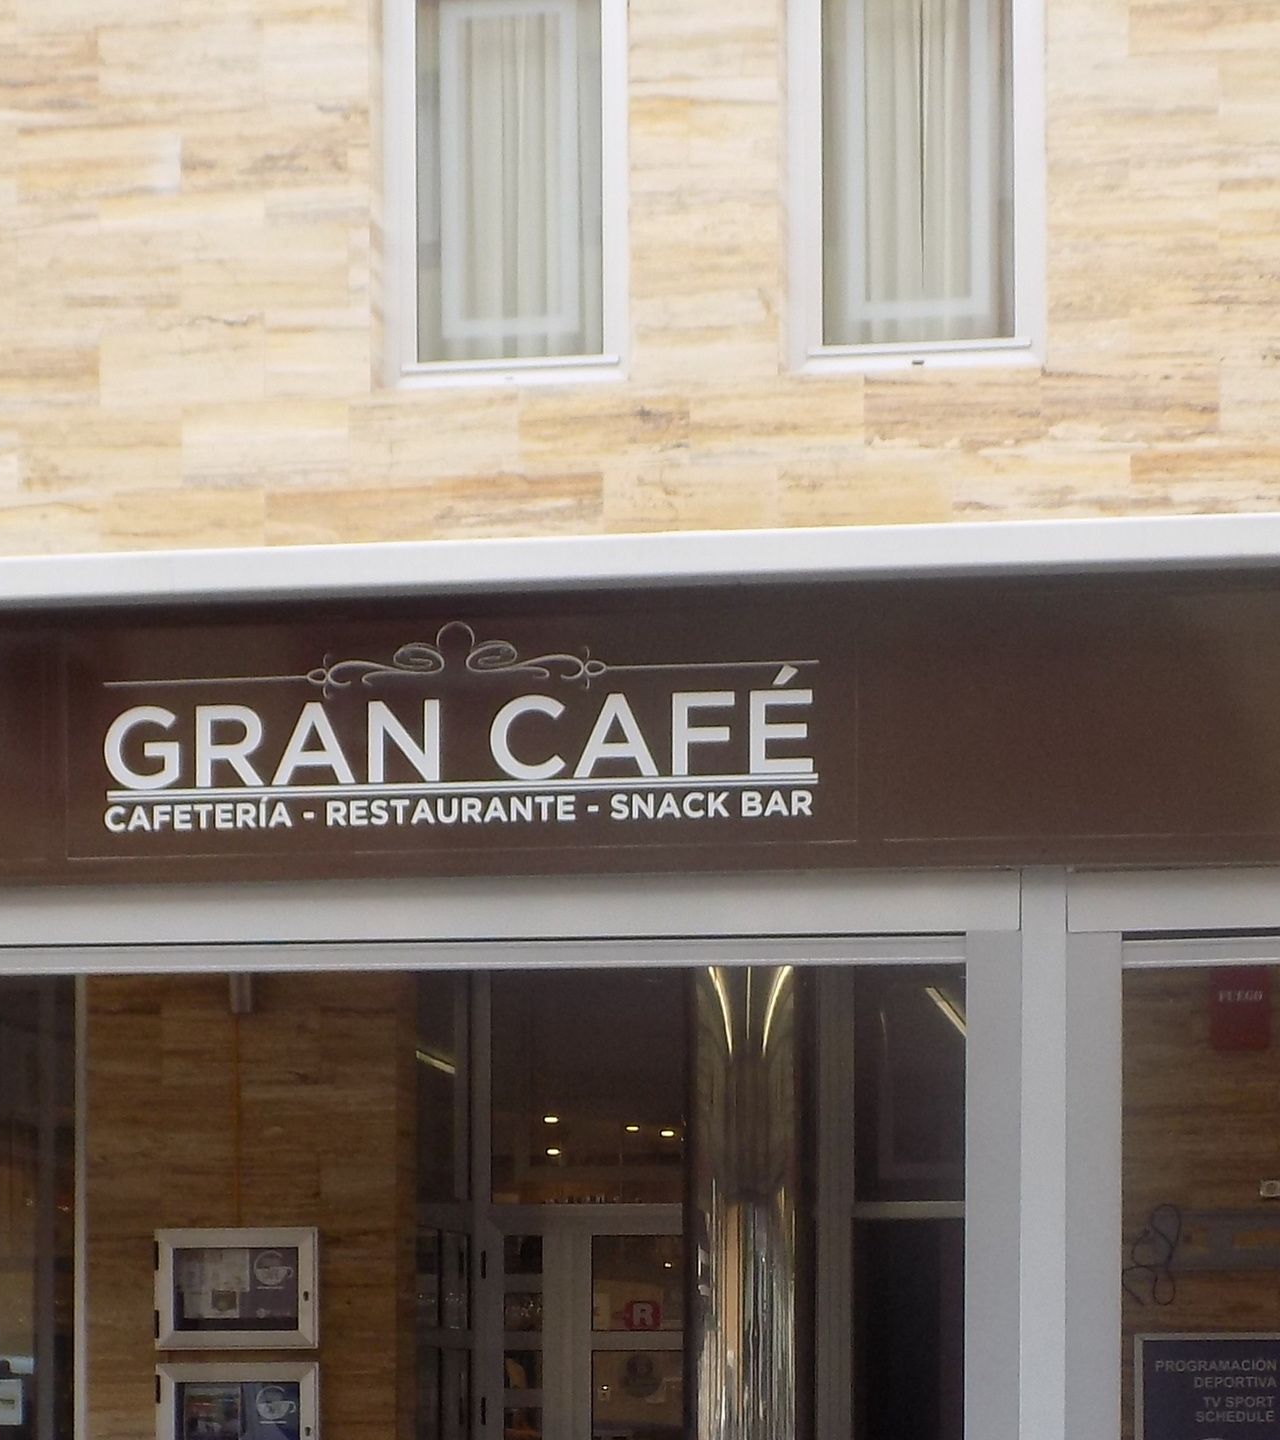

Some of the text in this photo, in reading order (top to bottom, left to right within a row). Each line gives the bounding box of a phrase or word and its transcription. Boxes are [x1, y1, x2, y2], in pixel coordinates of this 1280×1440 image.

[104, 664, 814, 790] GRAN CAFÉ
[104, 797, 293, 832] CAFETERÍA
[326, 796, 576, 828] RESTAURANTE
[610, 791, 729, 821] SNACK
[741, 789, 813, 818] BAR
[1193, 1376, 1277, 1388] DEPORTIVA
[1203, 1396, 1275, 1409] TV SPORT
[1195, 1411, 1275, 1423] SCHEDULE
